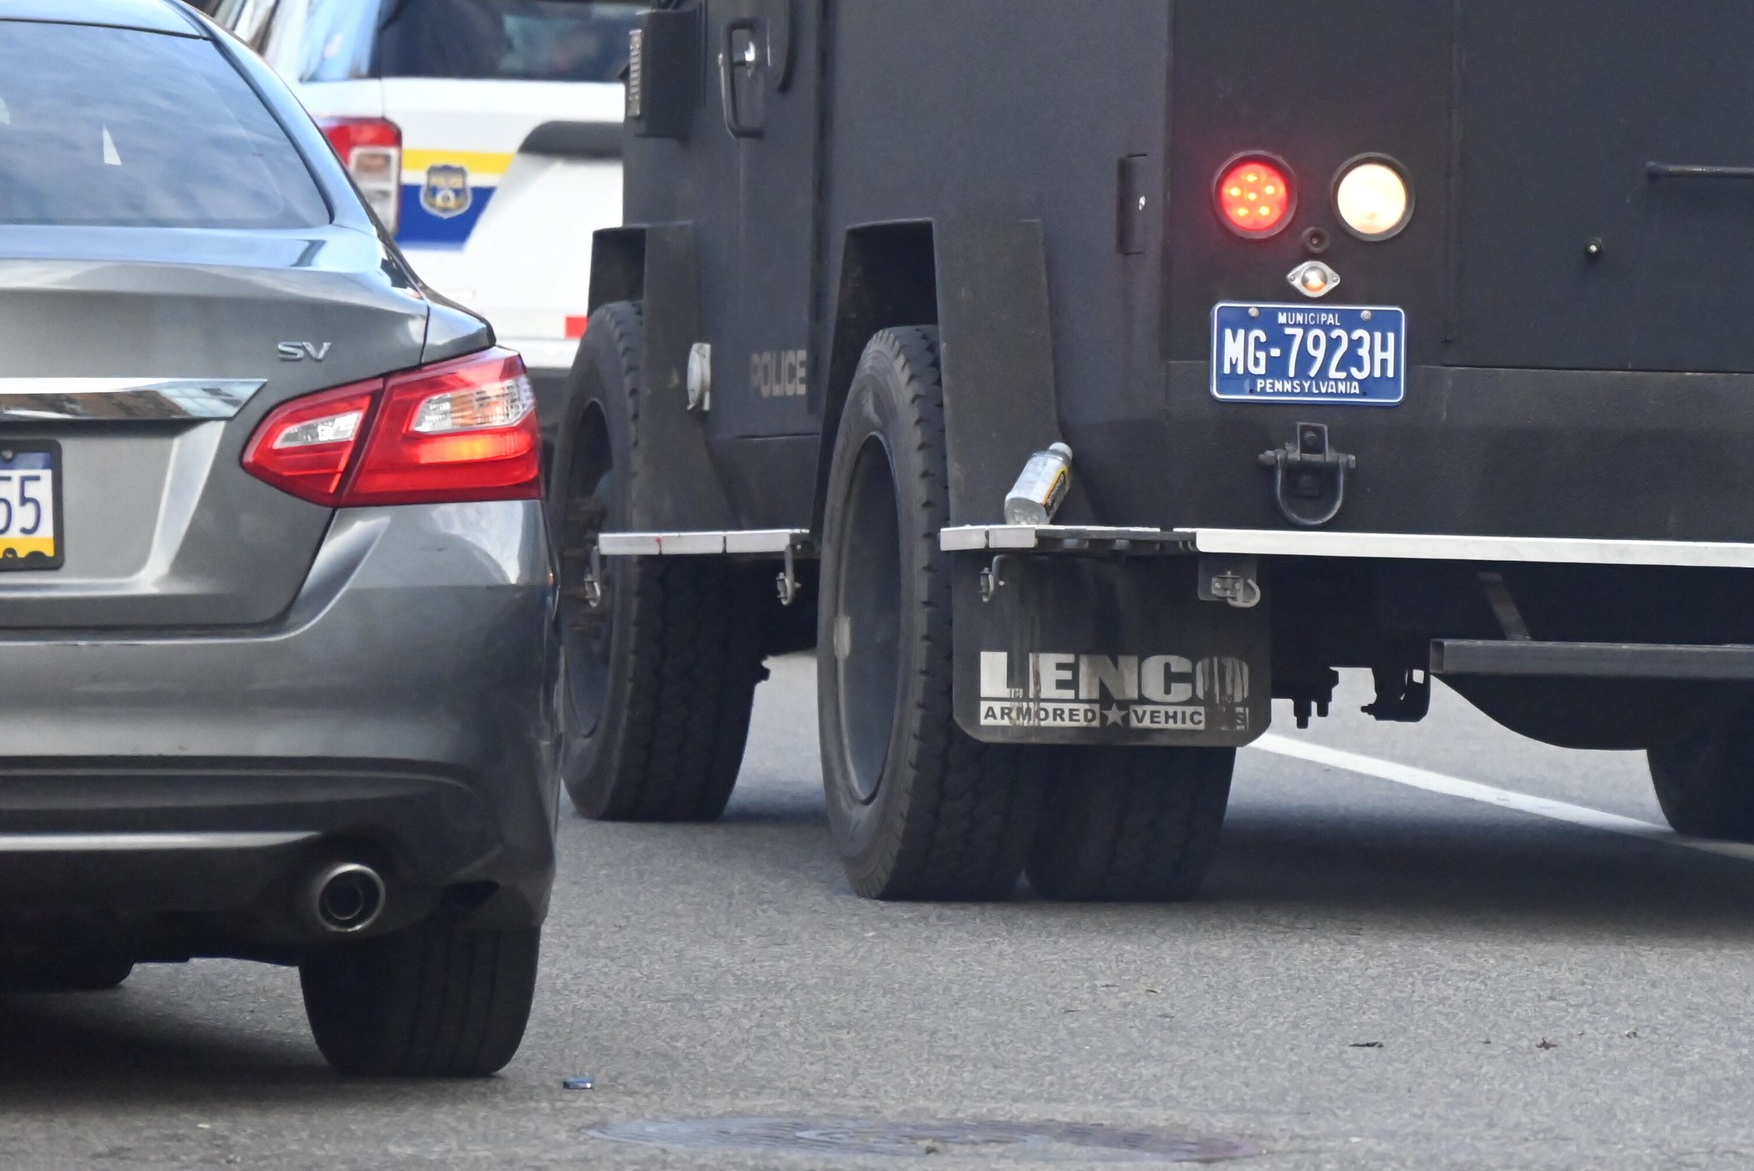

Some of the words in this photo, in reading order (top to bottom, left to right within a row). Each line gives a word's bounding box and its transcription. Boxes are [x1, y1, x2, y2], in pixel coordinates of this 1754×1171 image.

[1277, 311, 1341, 326] MUNICIPAL
[277, 341, 332, 362] SV
[1222, 327, 1396, 380] MG-7923H
[751, 349, 807, 398] POLICE
[1256, 379, 1360, 395] PENNSYLVANIA
[980, 651, 1249, 704] LENCO
[983, 705, 1097, 724] ARMORED
